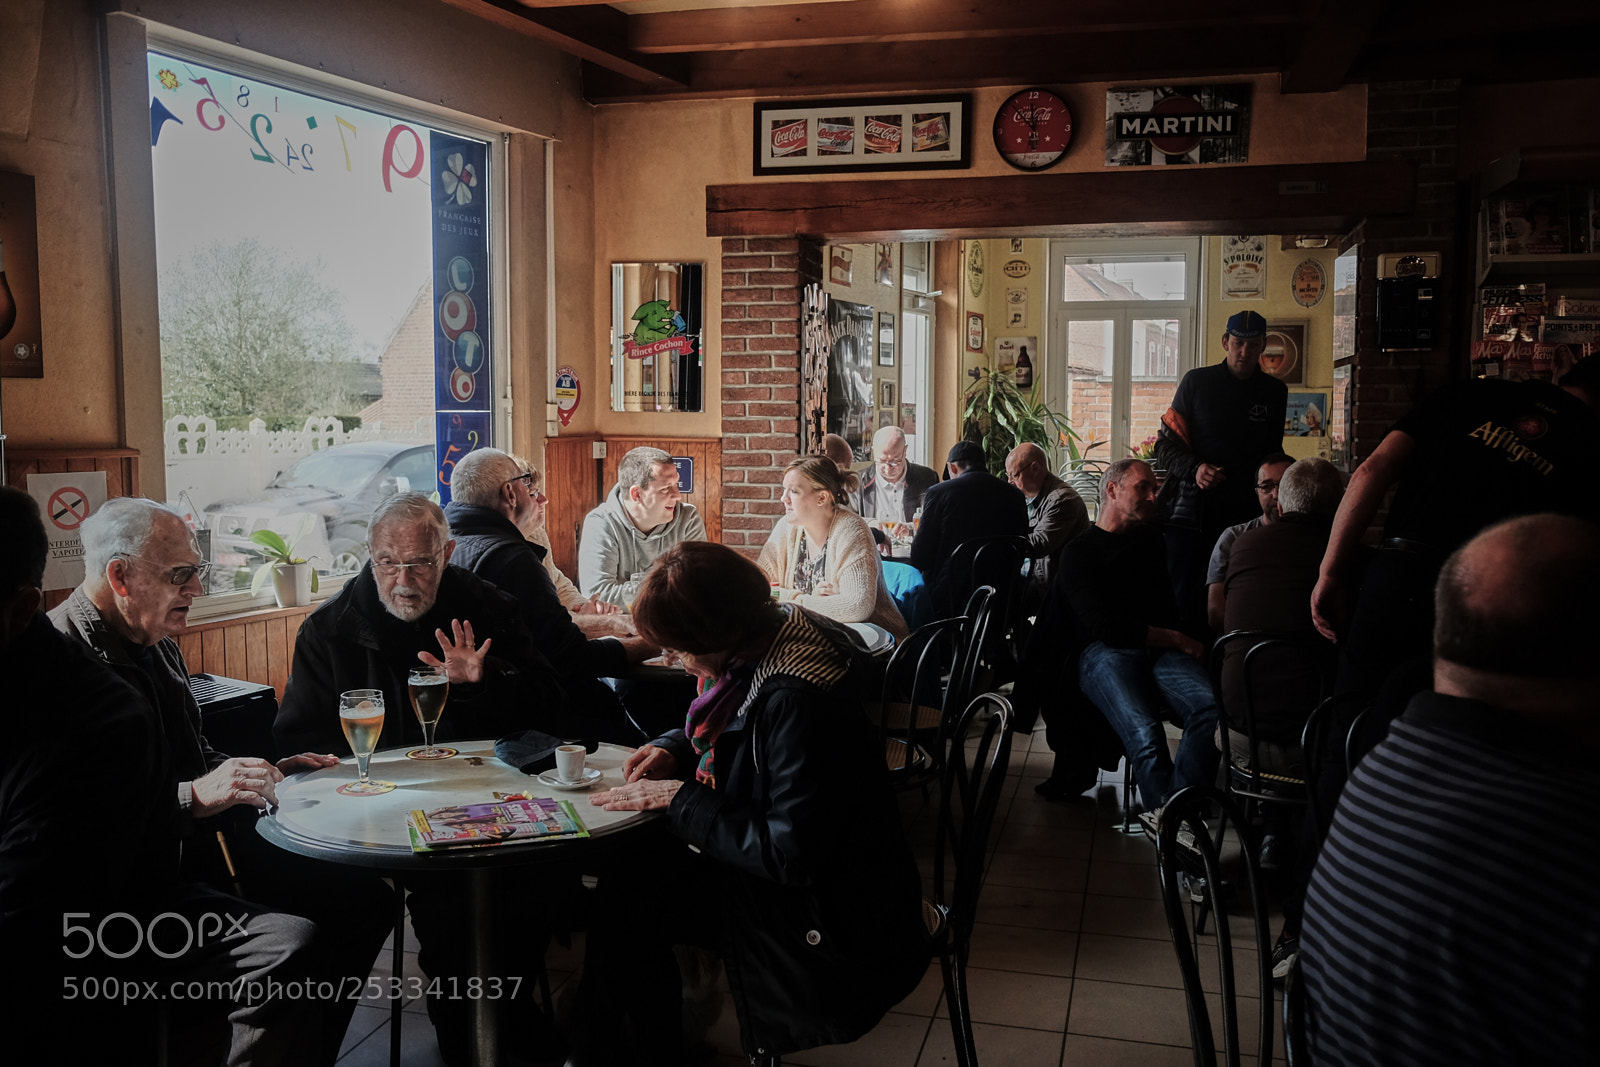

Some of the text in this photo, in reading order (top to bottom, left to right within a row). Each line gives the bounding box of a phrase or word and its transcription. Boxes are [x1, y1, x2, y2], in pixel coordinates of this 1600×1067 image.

[1028, 91, 1039, 99] 12
[1064, 124, 1072, 132] 3
[1121, 115, 1232, 135] MARTINI
[1544, 323, 1572, 331] POINTS
[631, 339, 684, 357] Rince Cochon
[452, 414, 462, 430] 9
[1468, 421, 1554, 476] Affligem
